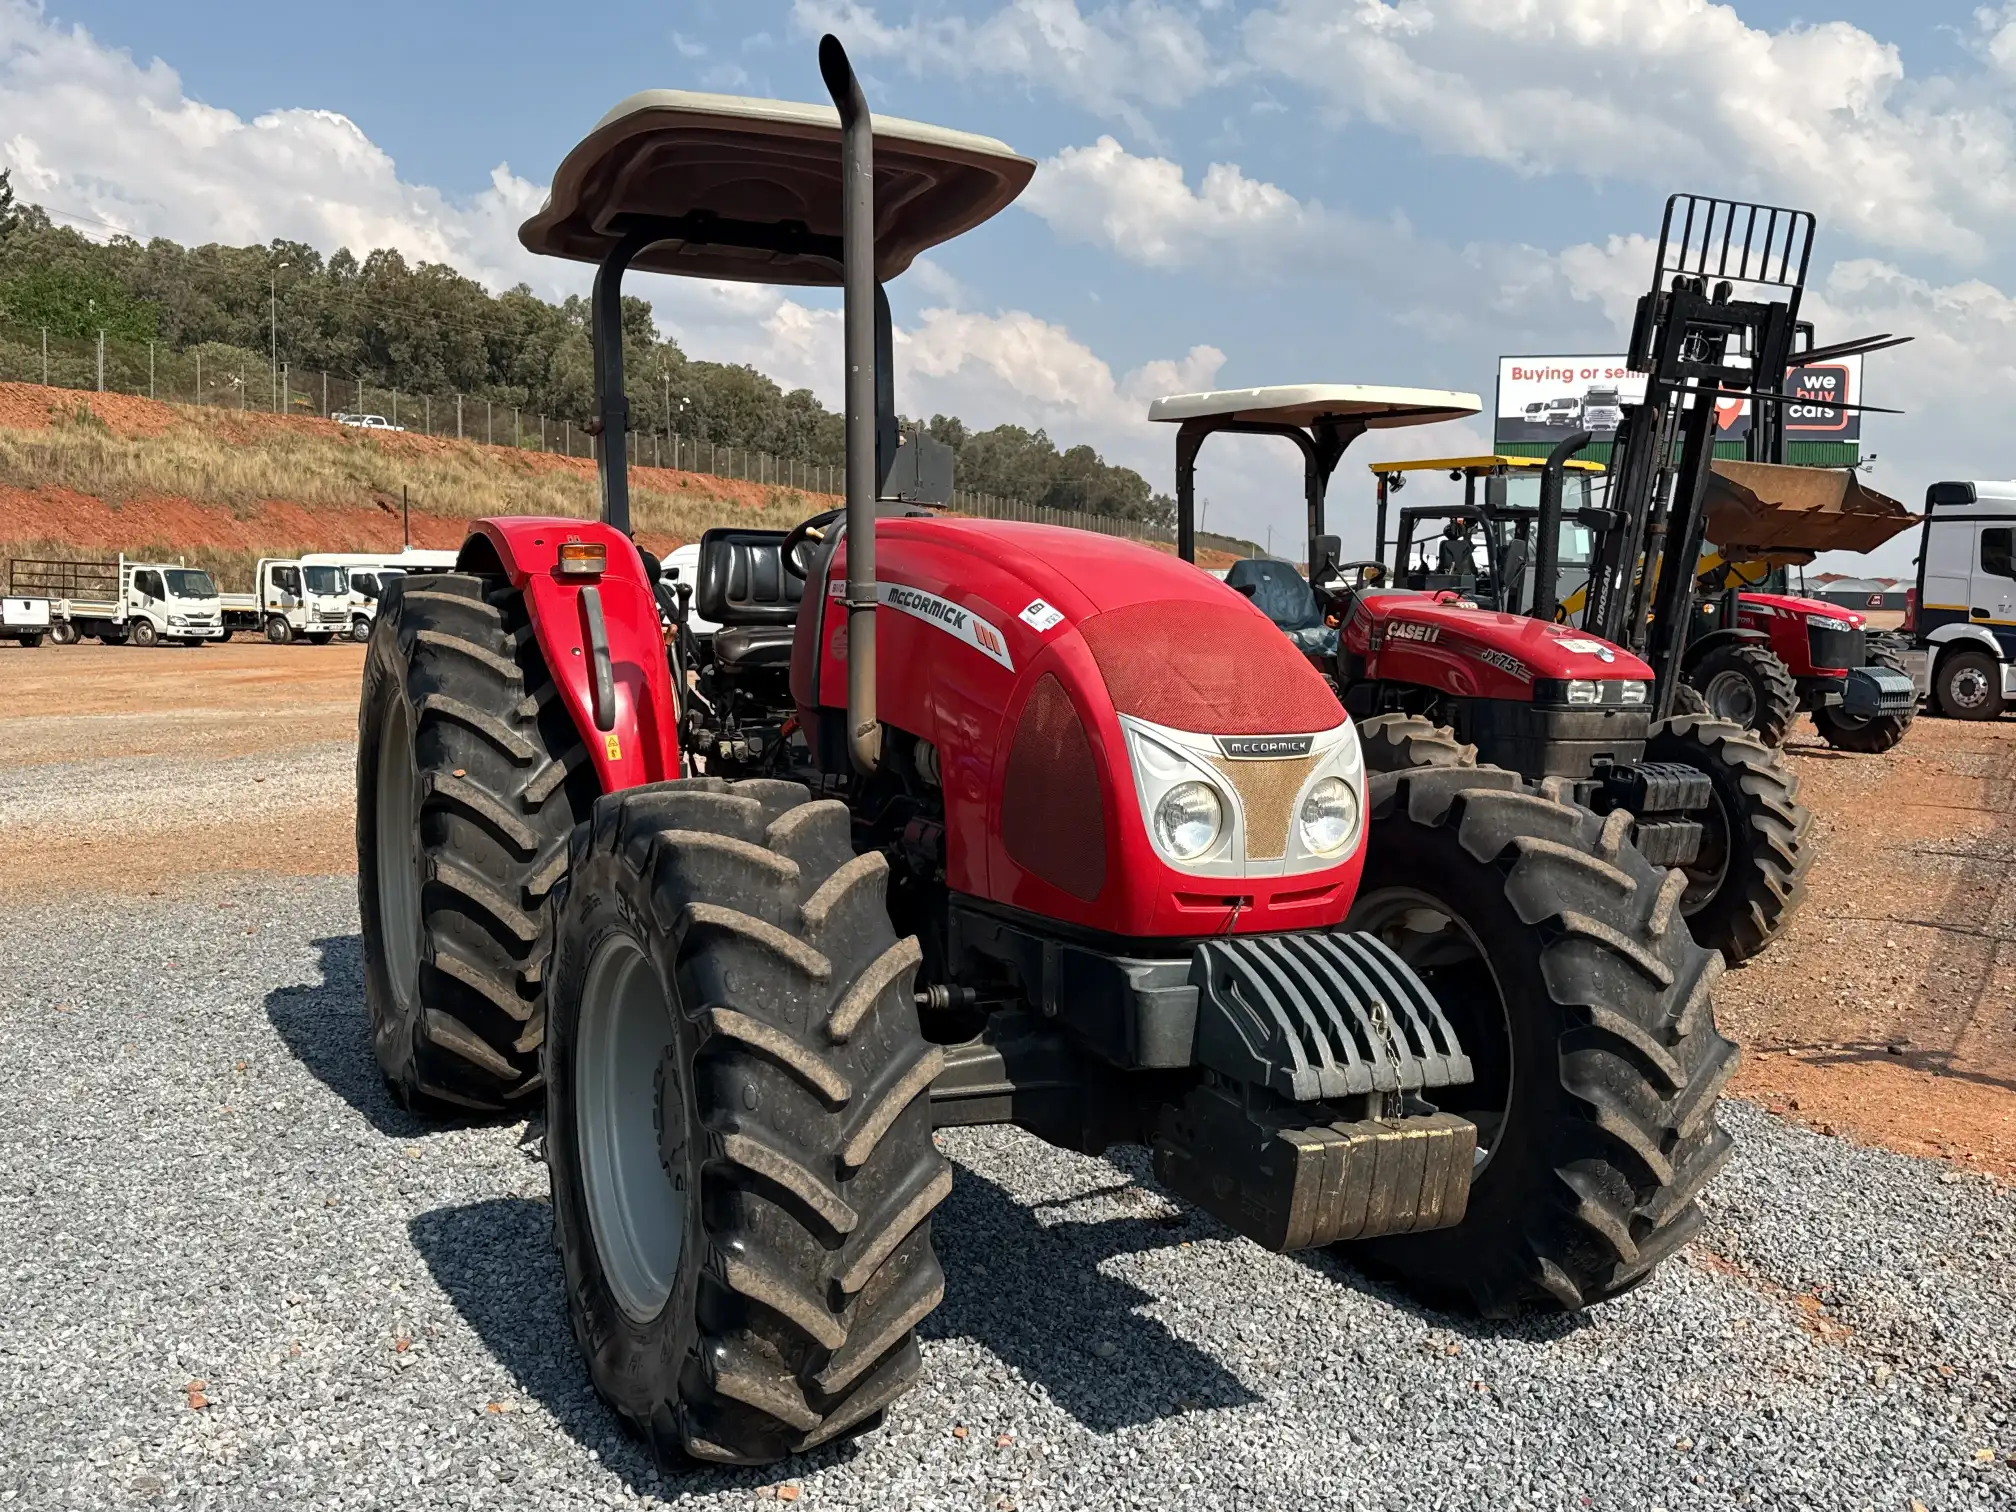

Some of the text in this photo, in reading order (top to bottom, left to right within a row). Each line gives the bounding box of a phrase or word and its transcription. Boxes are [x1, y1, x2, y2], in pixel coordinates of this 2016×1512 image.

[1512, 367, 1574, 383] Buying
[1580, 368, 1599, 379] or
[1803, 376, 1836, 389] we
[1789, 405, 1834, 418] cars
[1597, 565, 1612, 626] DOOSAN
[888, 588, 967, 629] McCORMICK
[1388, 622, 1425, 640] CASE
[1231, 742, 1306, 753] McCORMICK
